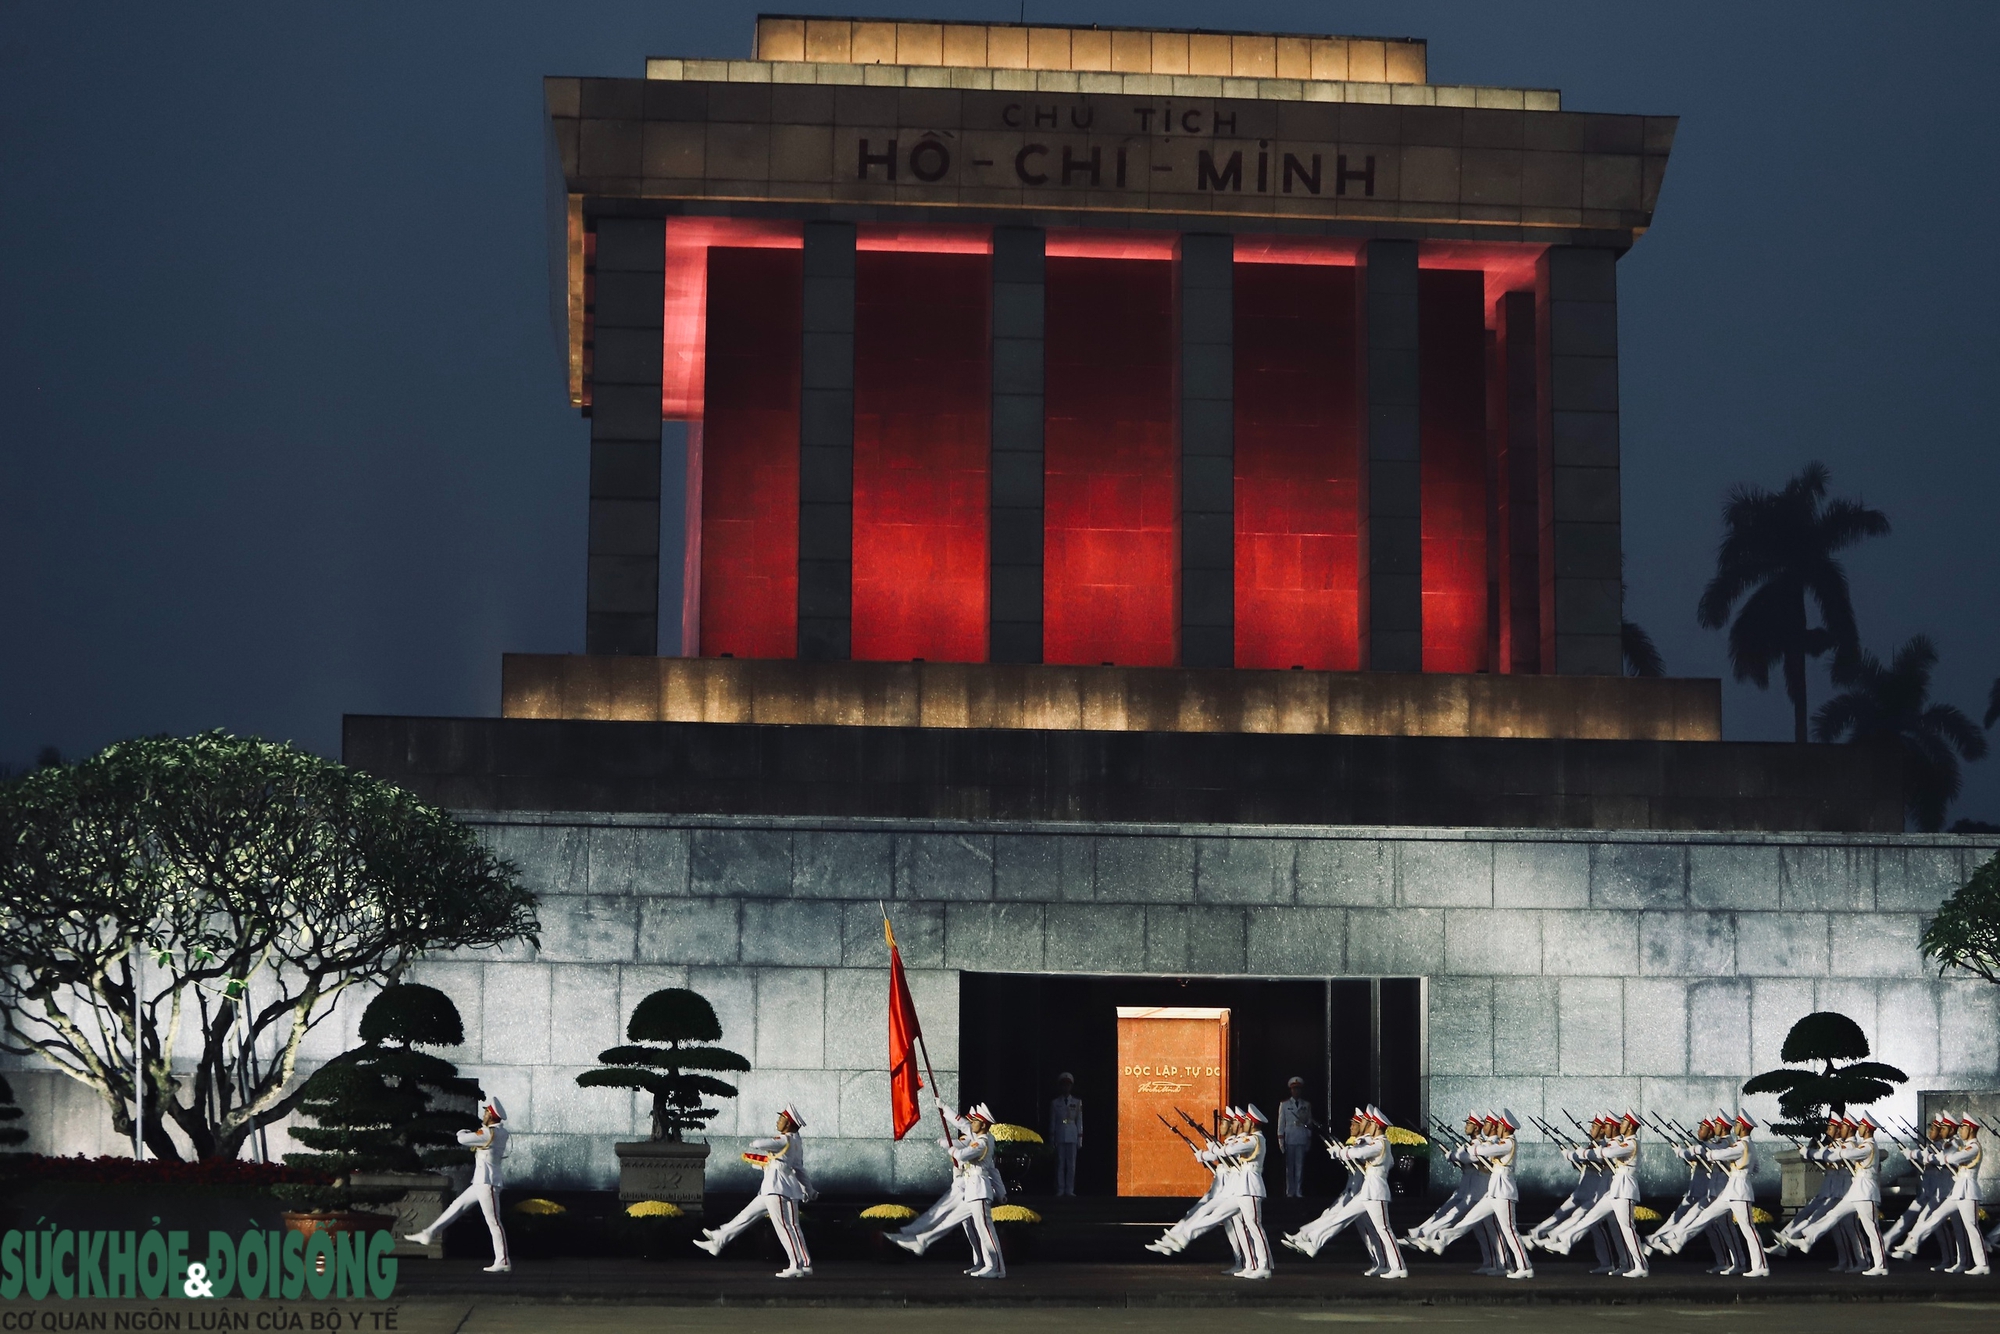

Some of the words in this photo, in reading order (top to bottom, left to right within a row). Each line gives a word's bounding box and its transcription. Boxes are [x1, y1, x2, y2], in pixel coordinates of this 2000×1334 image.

[857, 130, 955, 182] HỒ
[1198, 138, 1376, 197] MINH
[1124, 1065, 1151, 1078] ĐỘC
